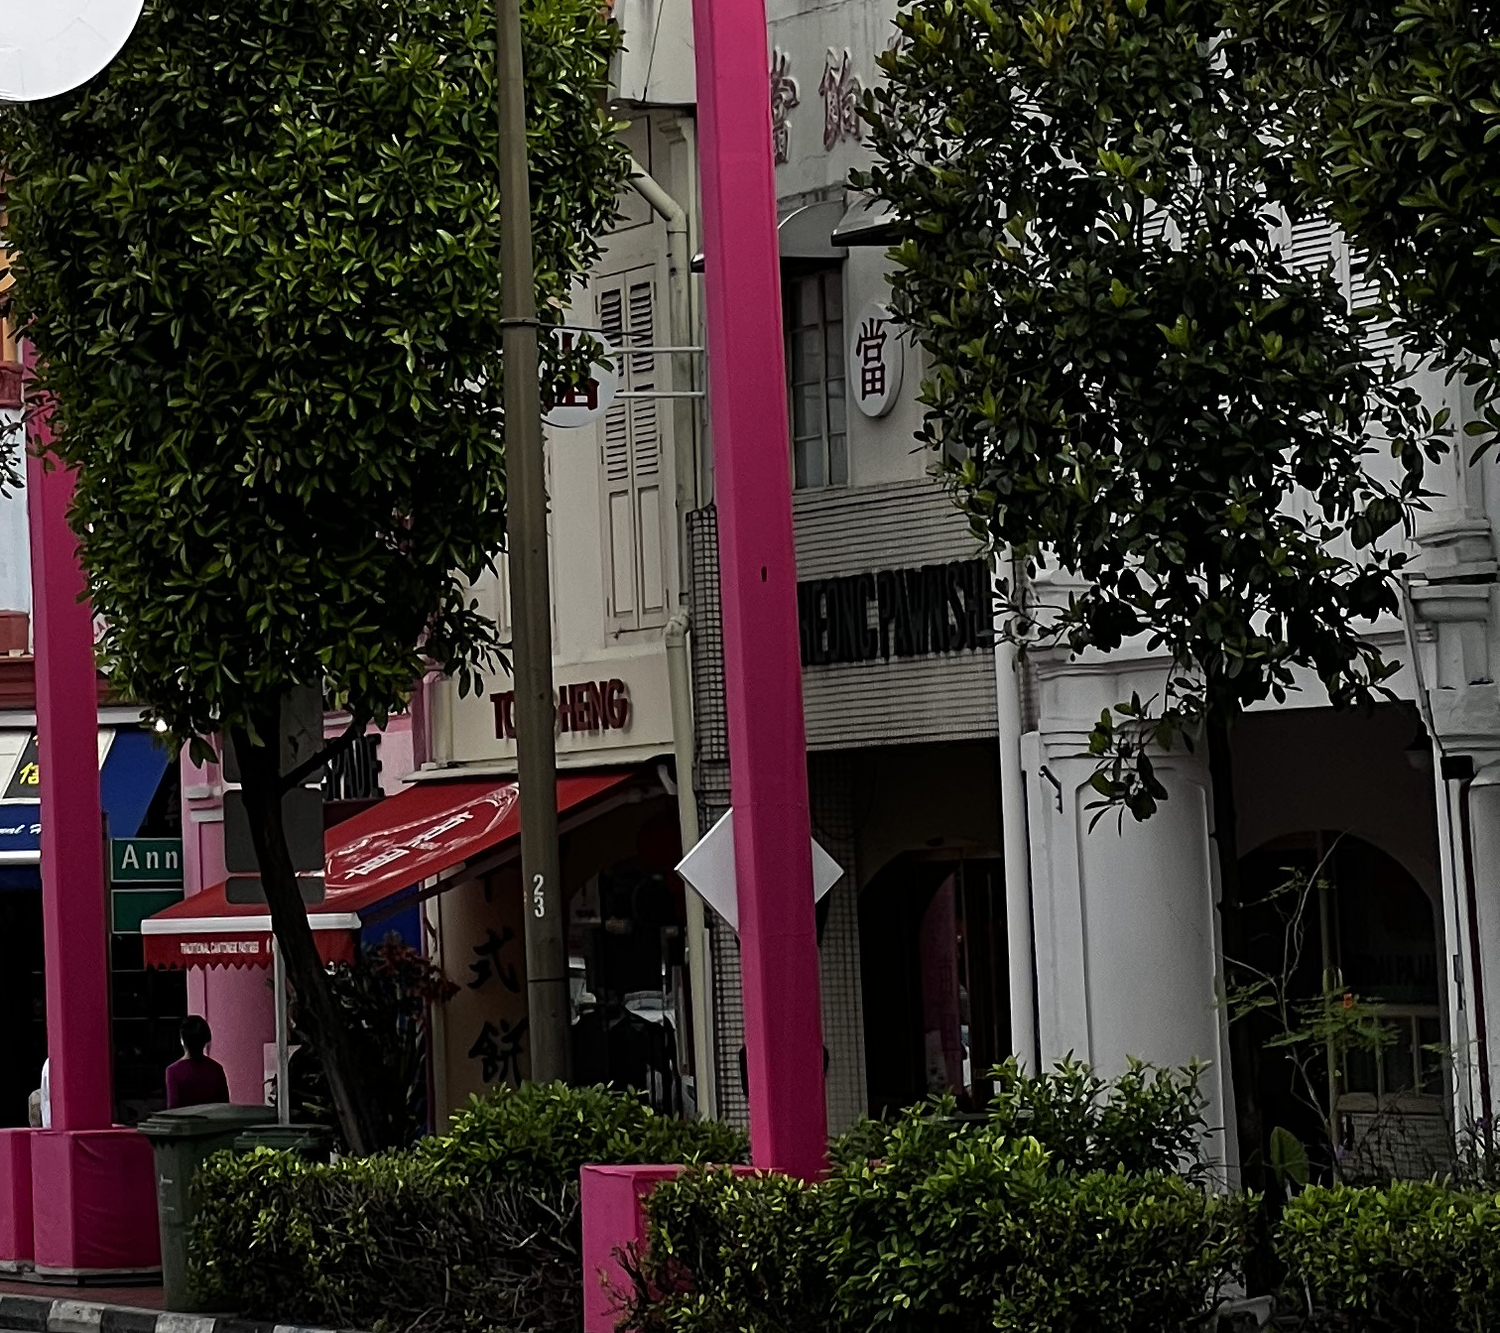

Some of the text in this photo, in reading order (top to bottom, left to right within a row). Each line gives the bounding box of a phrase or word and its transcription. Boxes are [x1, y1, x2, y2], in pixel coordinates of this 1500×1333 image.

[856, 318, 888, 401] 當
[121, 843, 179, 870] Ann
[532, 873, 545, 919] 23
